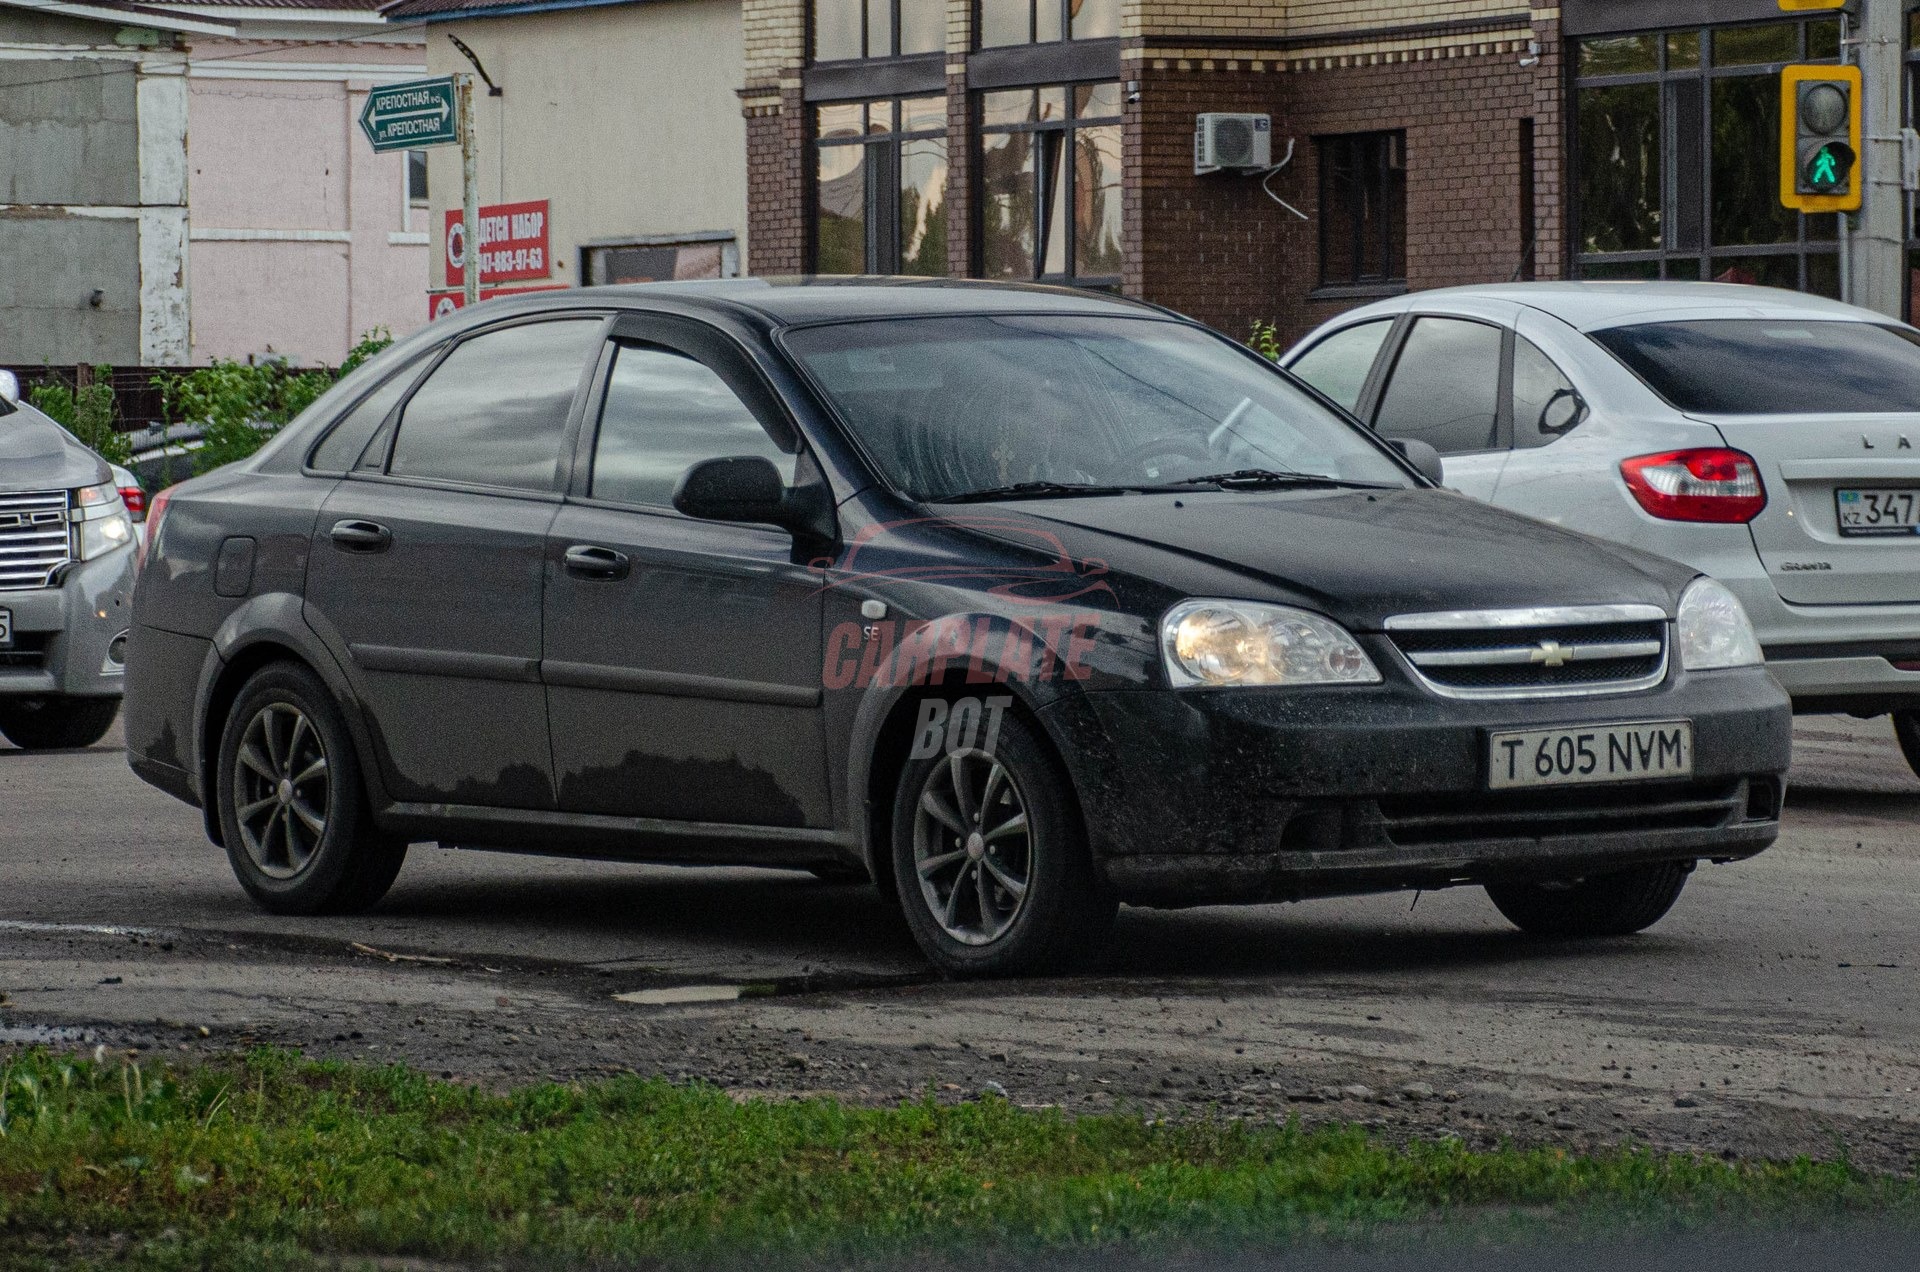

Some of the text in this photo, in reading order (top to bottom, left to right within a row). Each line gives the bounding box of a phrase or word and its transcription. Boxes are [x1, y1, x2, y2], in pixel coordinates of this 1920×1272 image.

[376, 91, 429, 111] КРЕПОСТНАЯ
[387, 117, 440, 137] КРЕПОСТНАЯ
[479, 215, 509, 247] ДЕТСЯ
[512, 211, 543, 240] НАБОР
[479, 247, 542, 273] 47-883-97-63
[1842, 494, 1913, 525] KZ 347
[863, 626, 879, 641] SE
[1502, 729, 1682, 780] T 605 NVM
